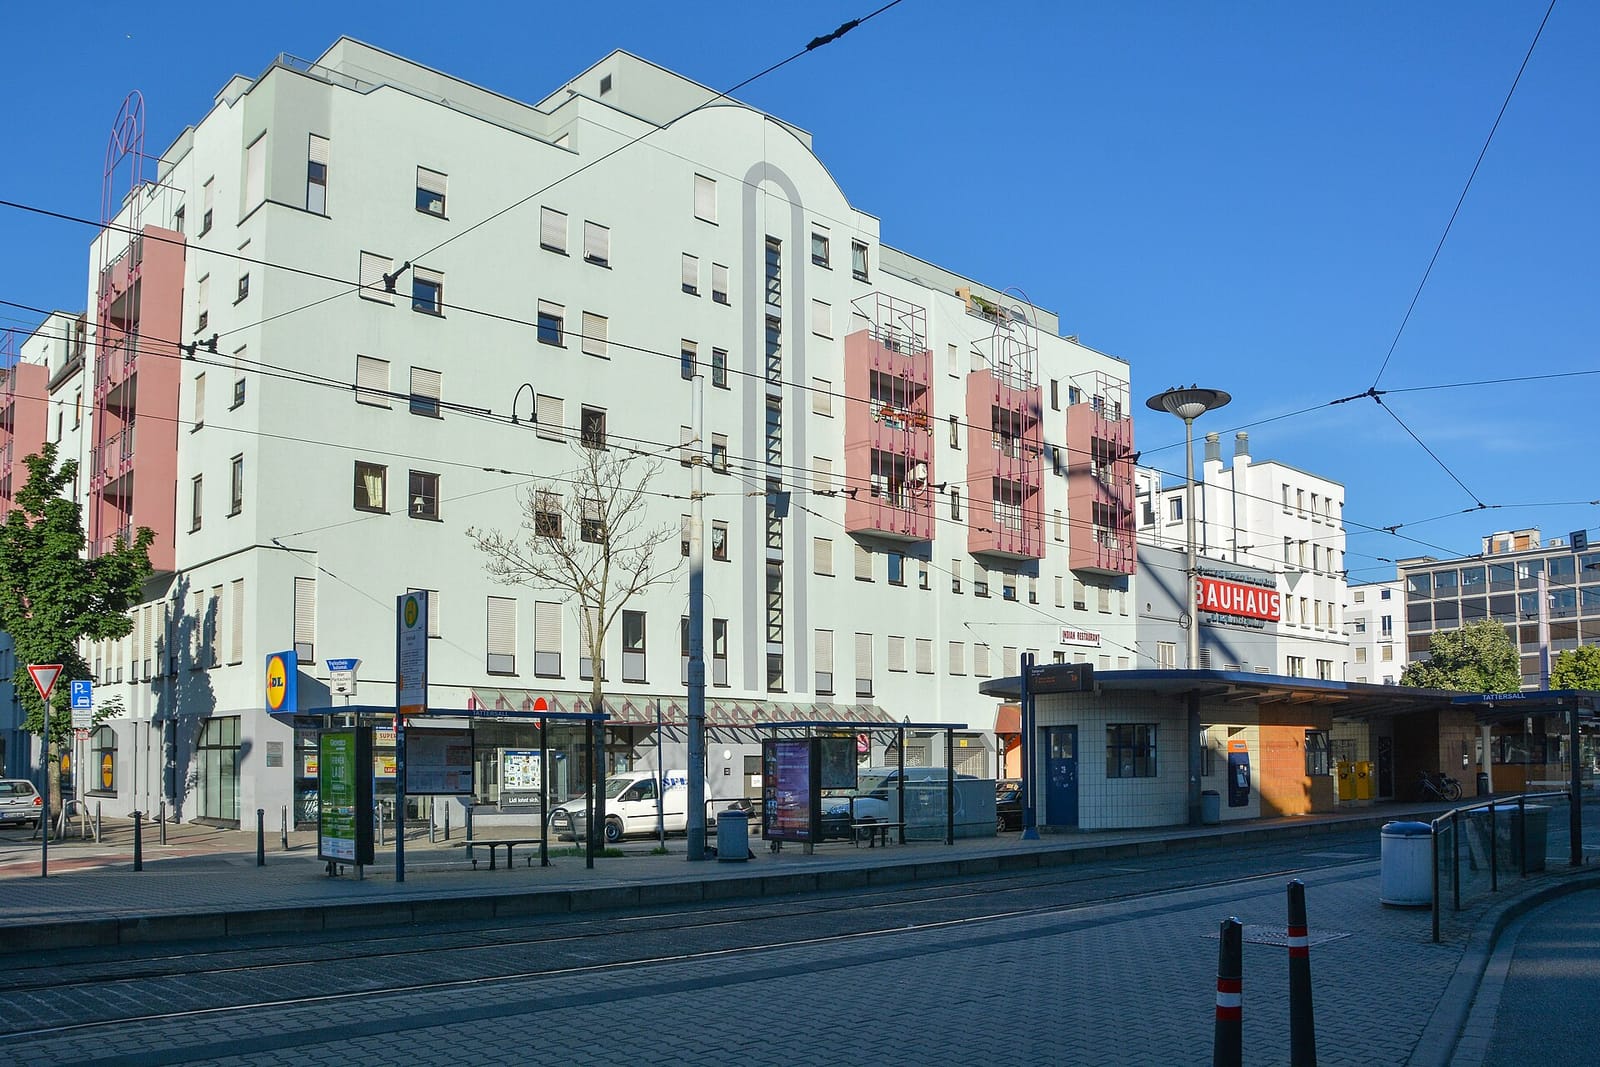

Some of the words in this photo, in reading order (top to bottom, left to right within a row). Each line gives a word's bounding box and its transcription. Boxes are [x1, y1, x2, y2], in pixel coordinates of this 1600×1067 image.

[1574, 534, 1585, 549] E
[1197, 581, 1279, 617] BAUHAUS
[74, 683, 84, 694] P
